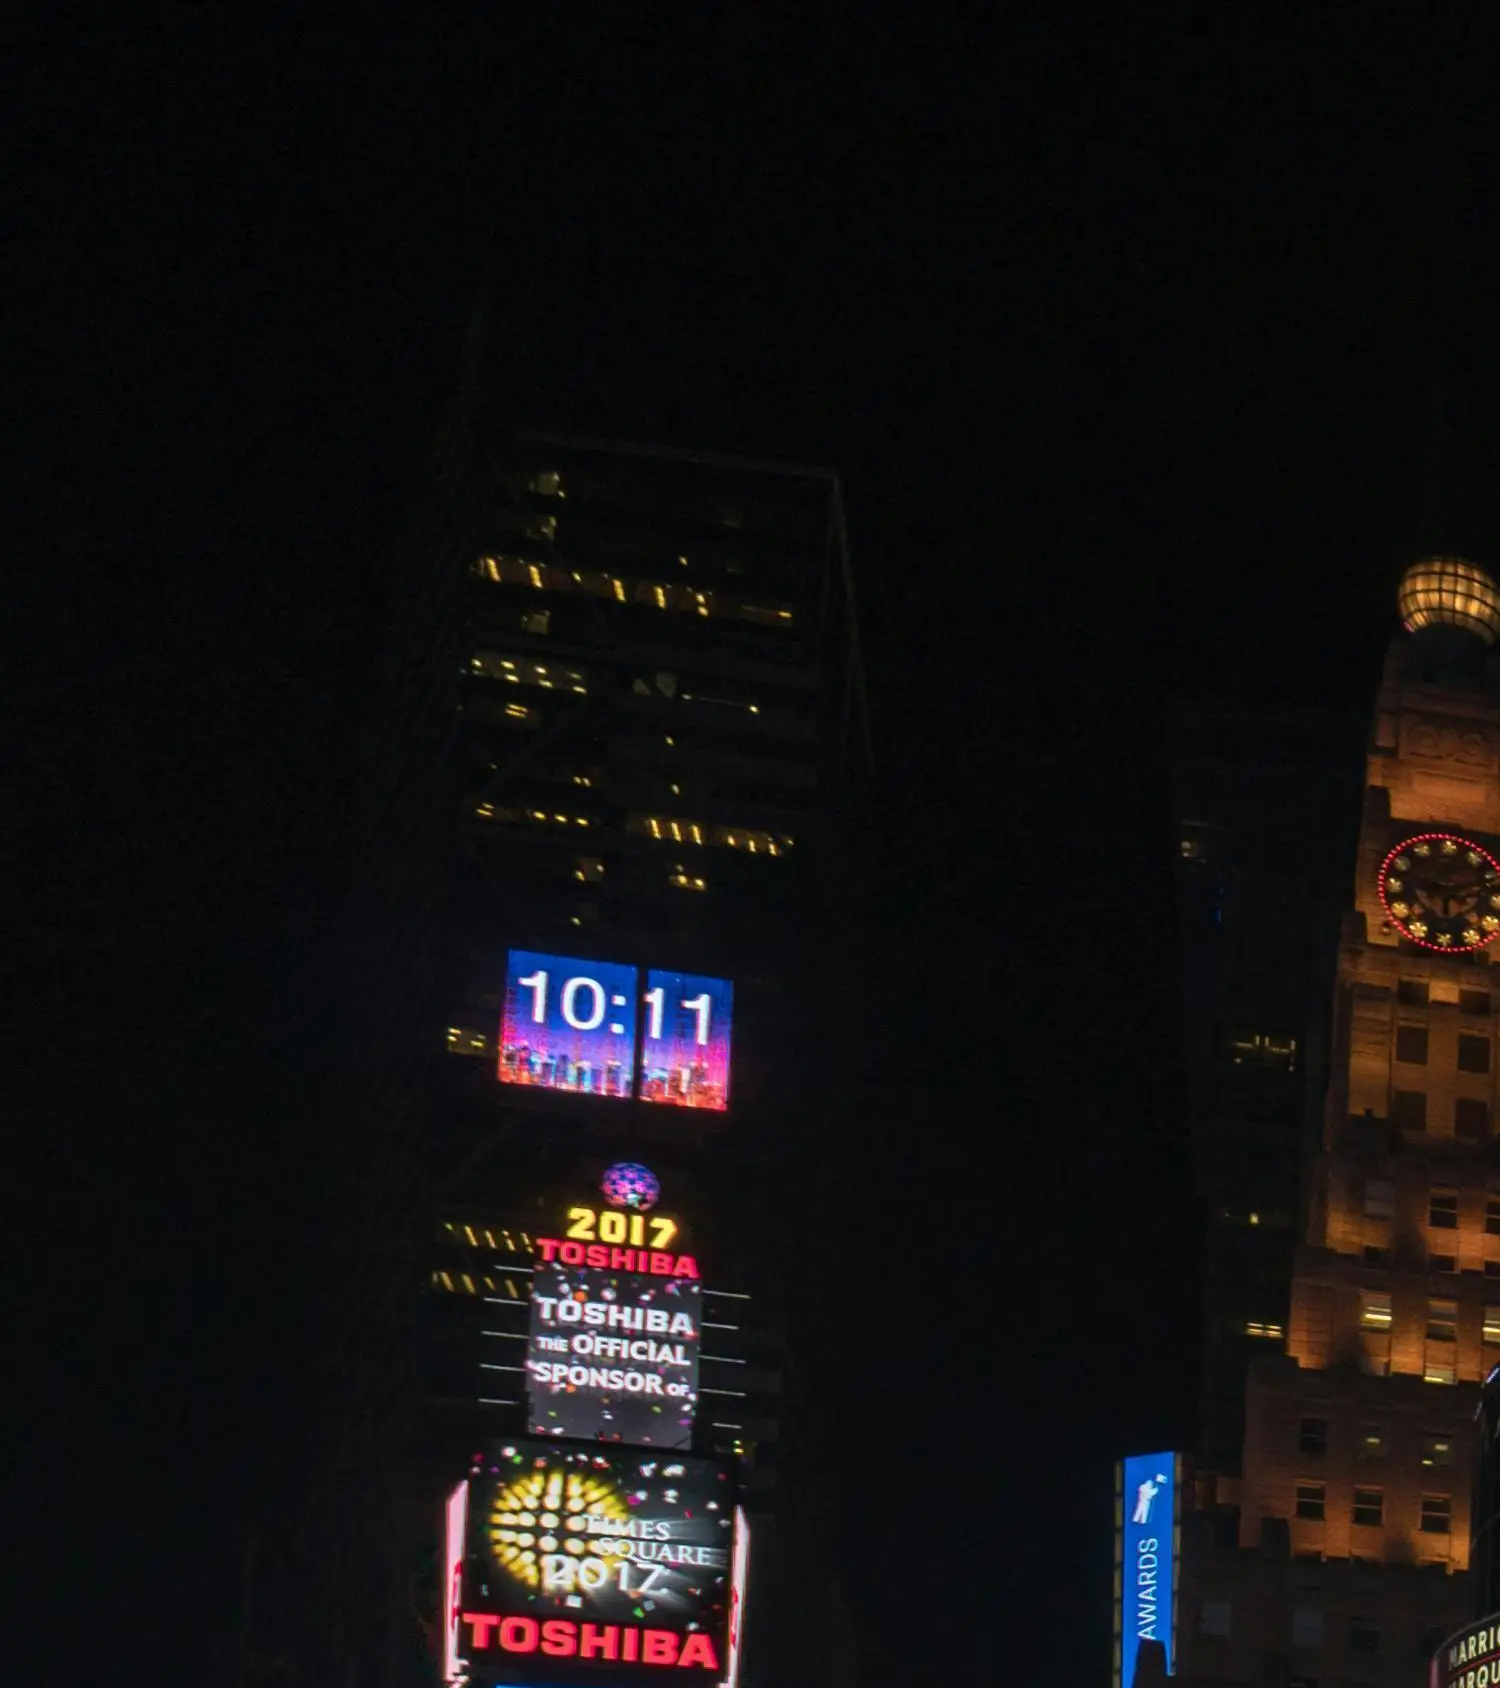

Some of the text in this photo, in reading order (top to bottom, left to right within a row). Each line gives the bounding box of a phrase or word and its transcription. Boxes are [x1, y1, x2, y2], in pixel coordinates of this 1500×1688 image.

[517, 970, 713, 1047] 10:11
[566, 1206, 678, 1249] 2017
[536, 1238, 700, 1279] TOSHIBA
[535, 1297, 695, 1335] TOSHIBA
[537, 1333, 691, 1366] THE OFFICIAL
[532, 1362, 664, 1396] SPONSOR
[582, 1512, 672, 1541] TIMES
[598, 1535, 714, 1566] SQUARE
[543, 1555, 667, 1593] 2017
[1137, 1537, 1159, 1640] AWARDS
[462, 1612, 719, 1670] TOSHIBA
